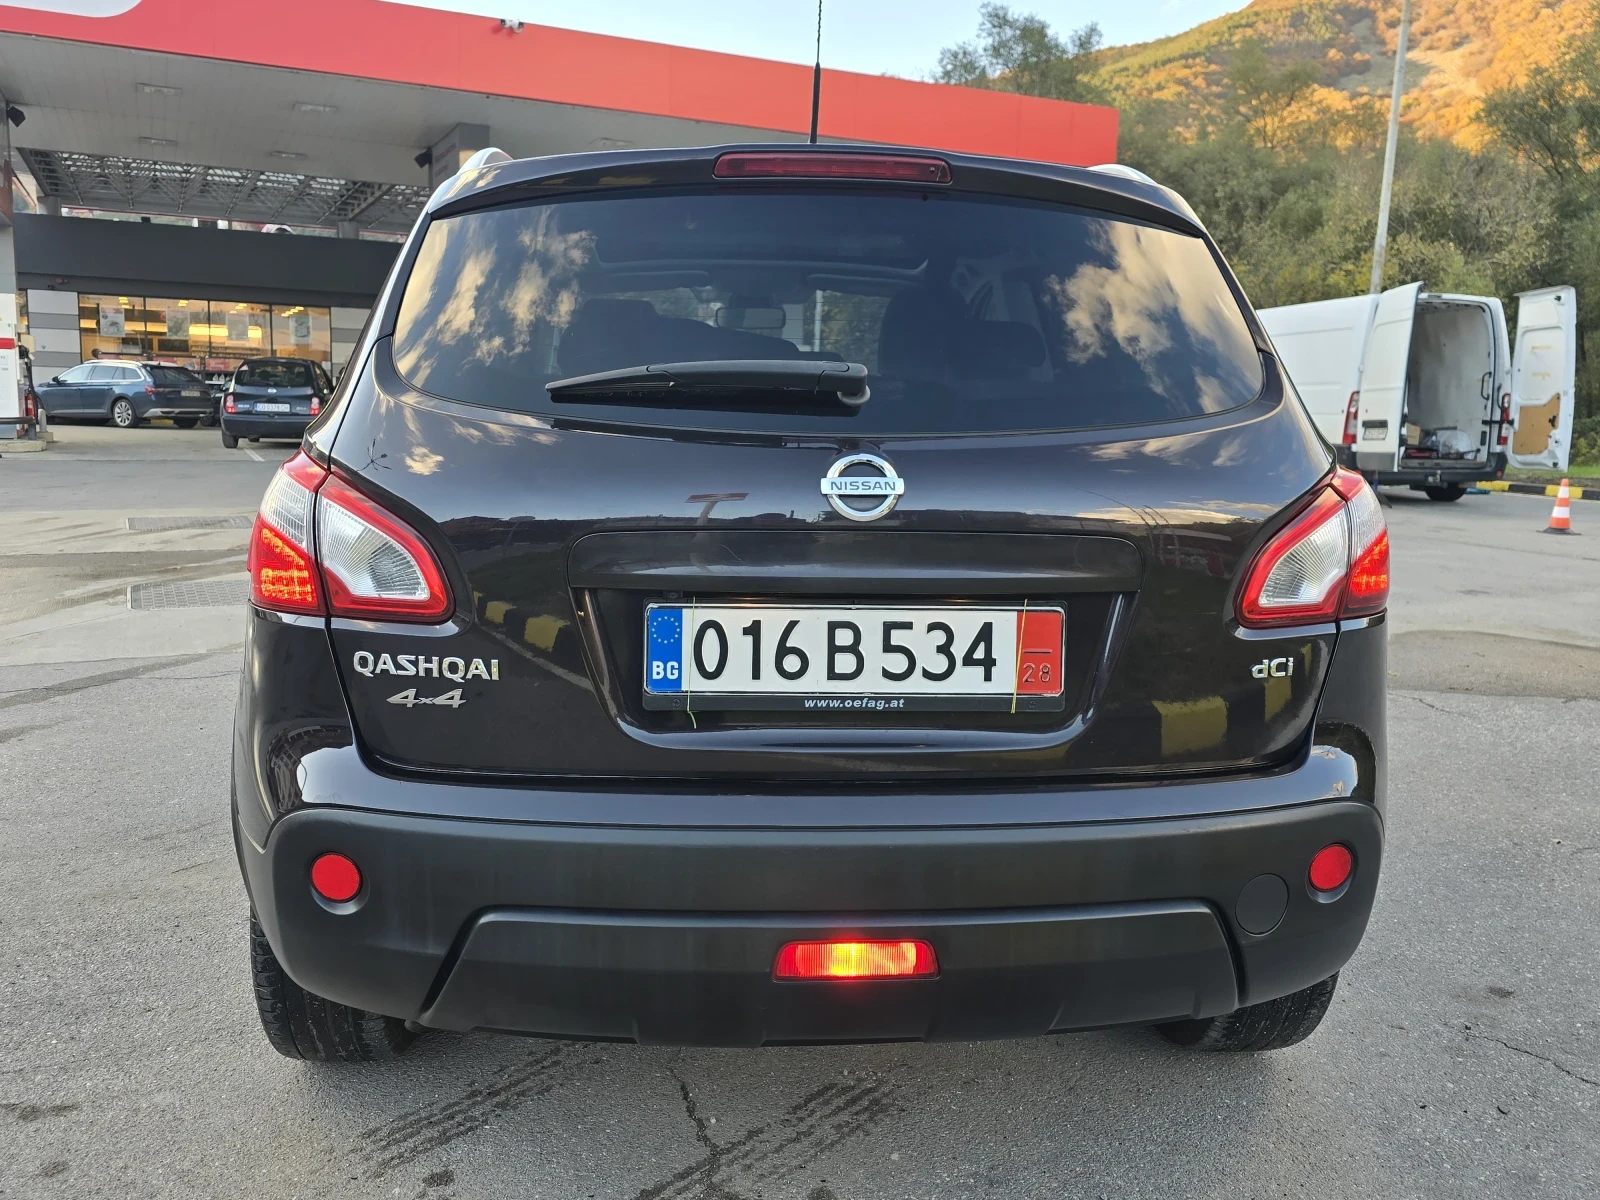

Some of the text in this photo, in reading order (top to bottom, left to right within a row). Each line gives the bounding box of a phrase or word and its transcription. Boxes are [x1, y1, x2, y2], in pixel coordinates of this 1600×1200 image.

[830, 481, 896, 491] NISSAN
[693, 619, 997, 682] 016 B 534
[353, 651, 500, 683] QASHQAI
[652, 661, 679, 680] BG
[1022, 662, 1051, 683] 28
[1251, 657, 1294, 679] dCi
[386, 688, 467, 708] 4x4
[804, 697, 905, 710] www.oefag.at
